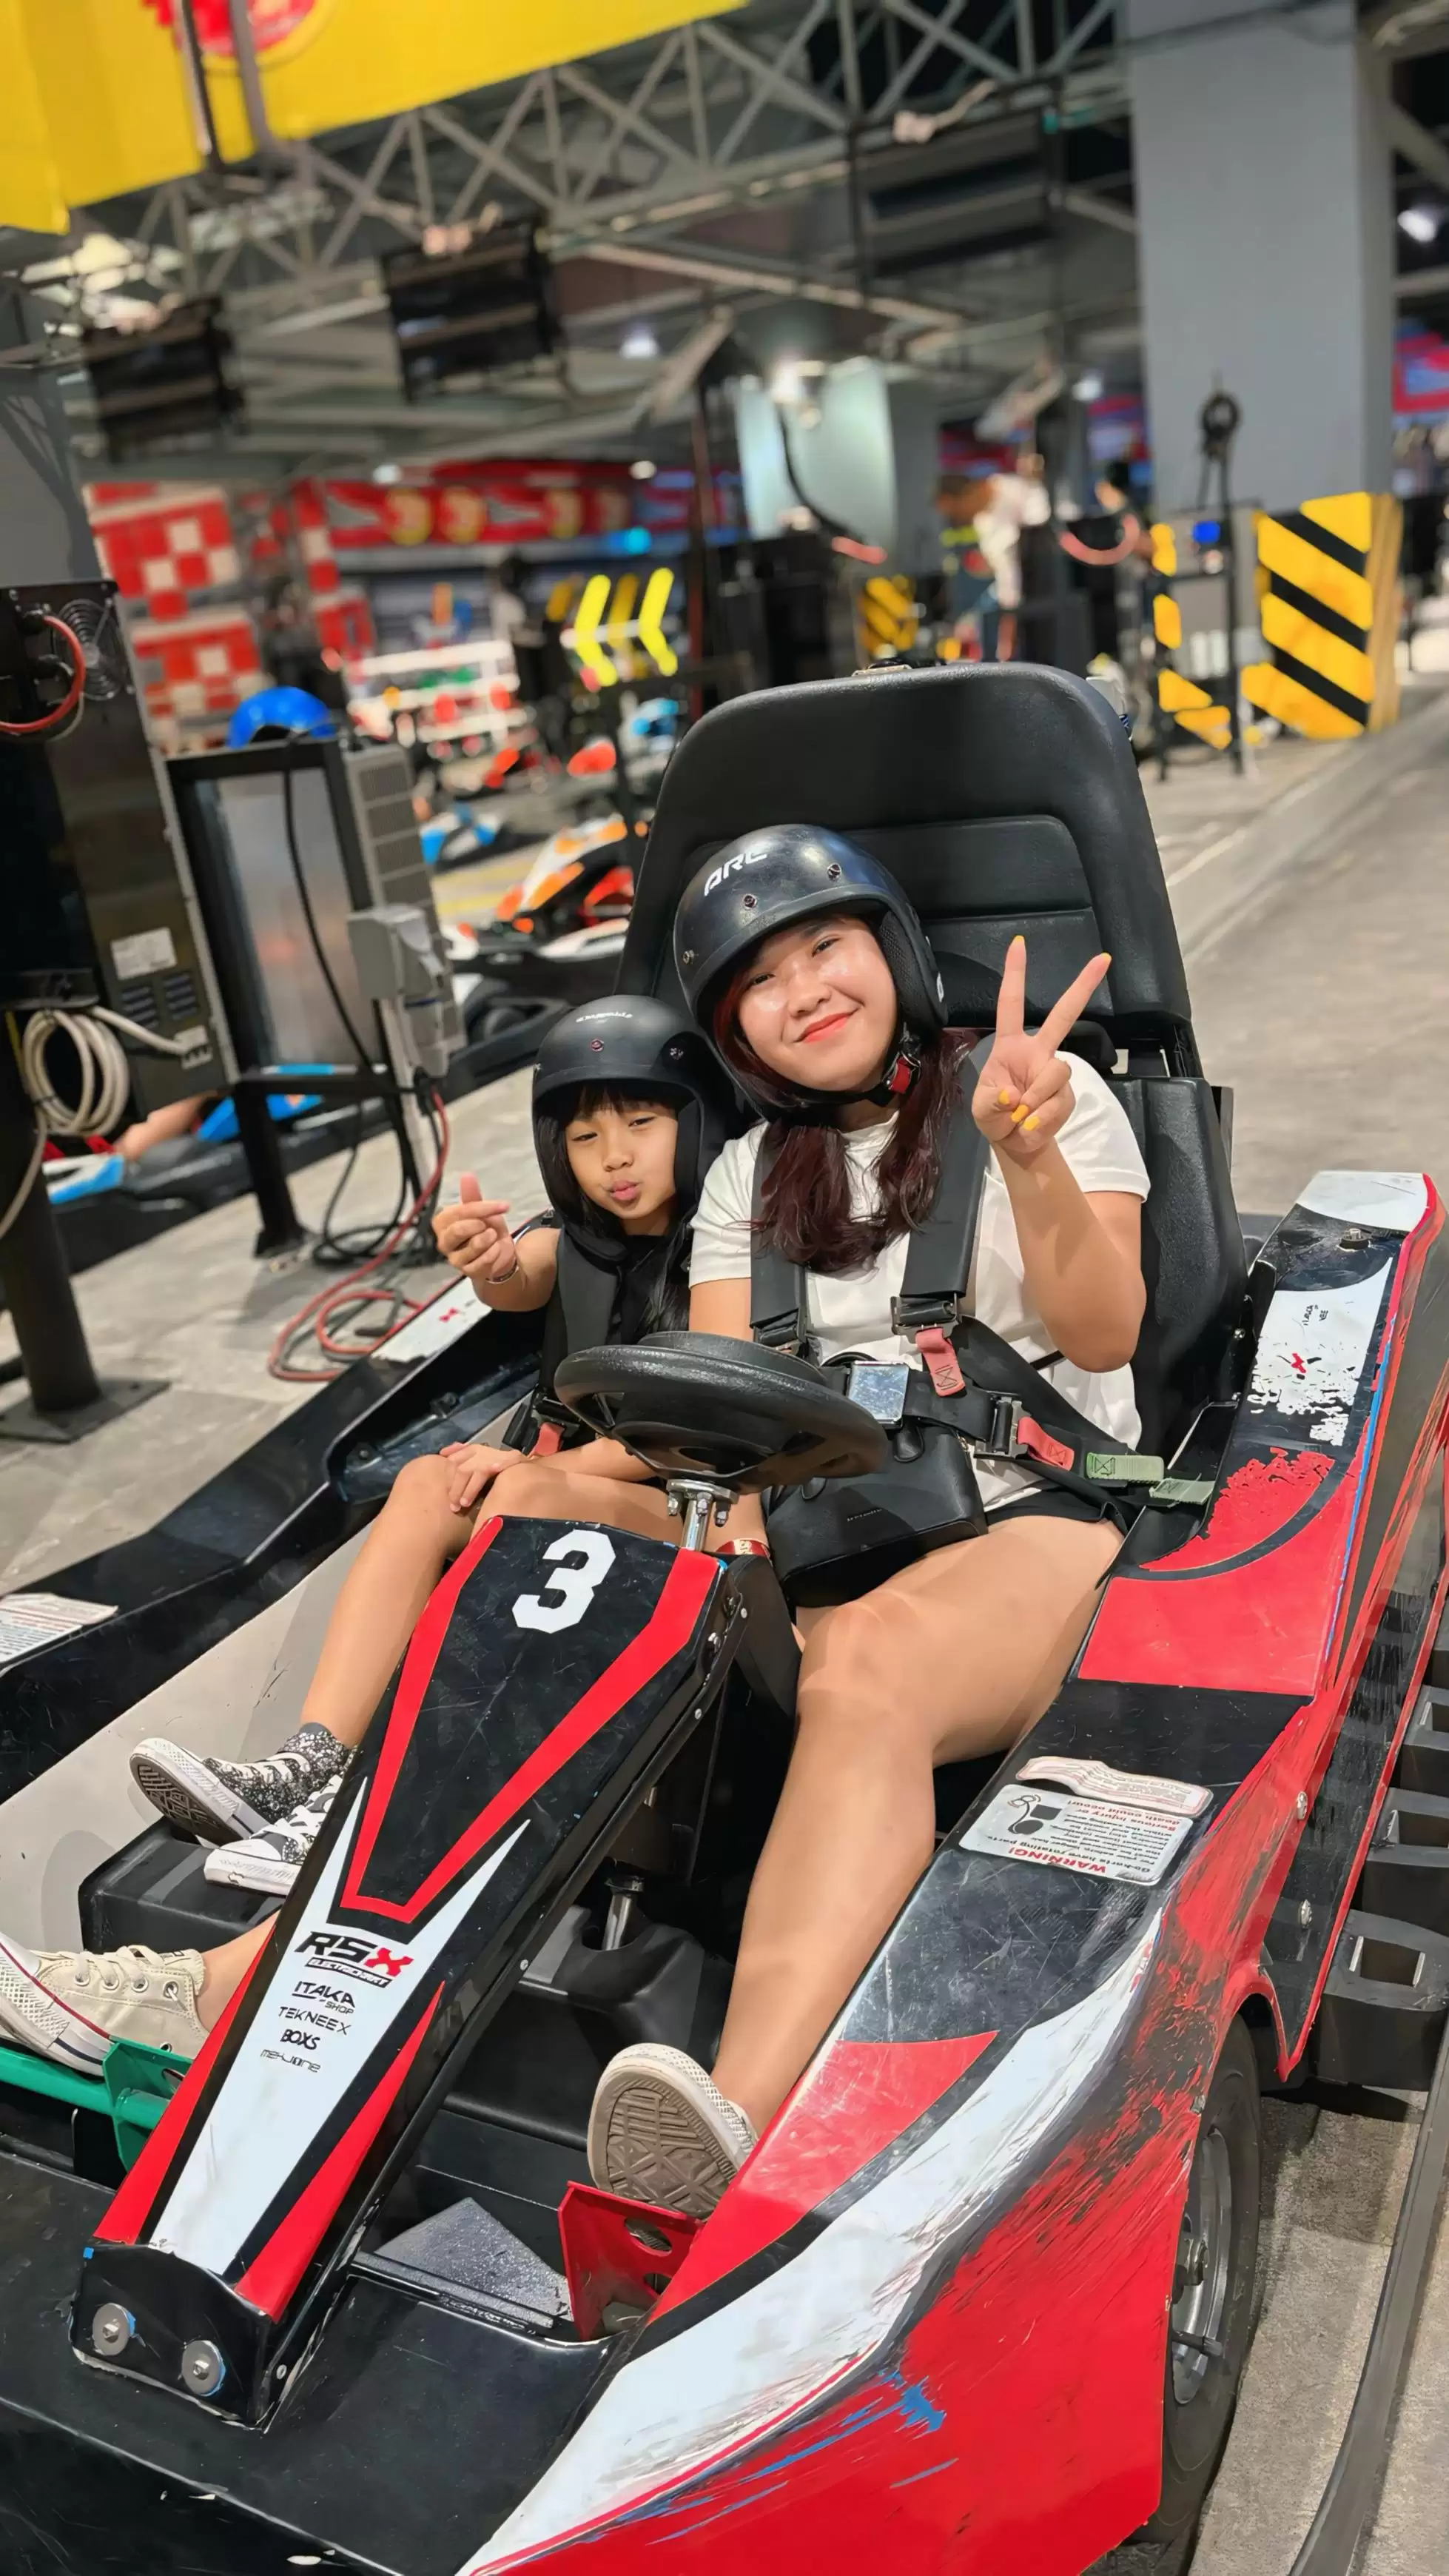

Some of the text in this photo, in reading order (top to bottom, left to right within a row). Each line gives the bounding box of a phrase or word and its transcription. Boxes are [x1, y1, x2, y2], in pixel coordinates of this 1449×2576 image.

[704, 849, 768, 896] ARC
[512, 1529, 616, 1634] 3
[1008, 1847, 1106, 1874] WARNING!
[1019, 1842, 1069, 1855] rotating
[1068, 1853, 1097, 1862] have
[295, 1931, 414, 1976] RSX
[294, 1981, 355, 2008] ITAKA
[278, 2006, 353, 2036] TEKNEEX
[324, 2002, 355, 2015] SHOP
[280, 2029, 321, 2050] BOXS
